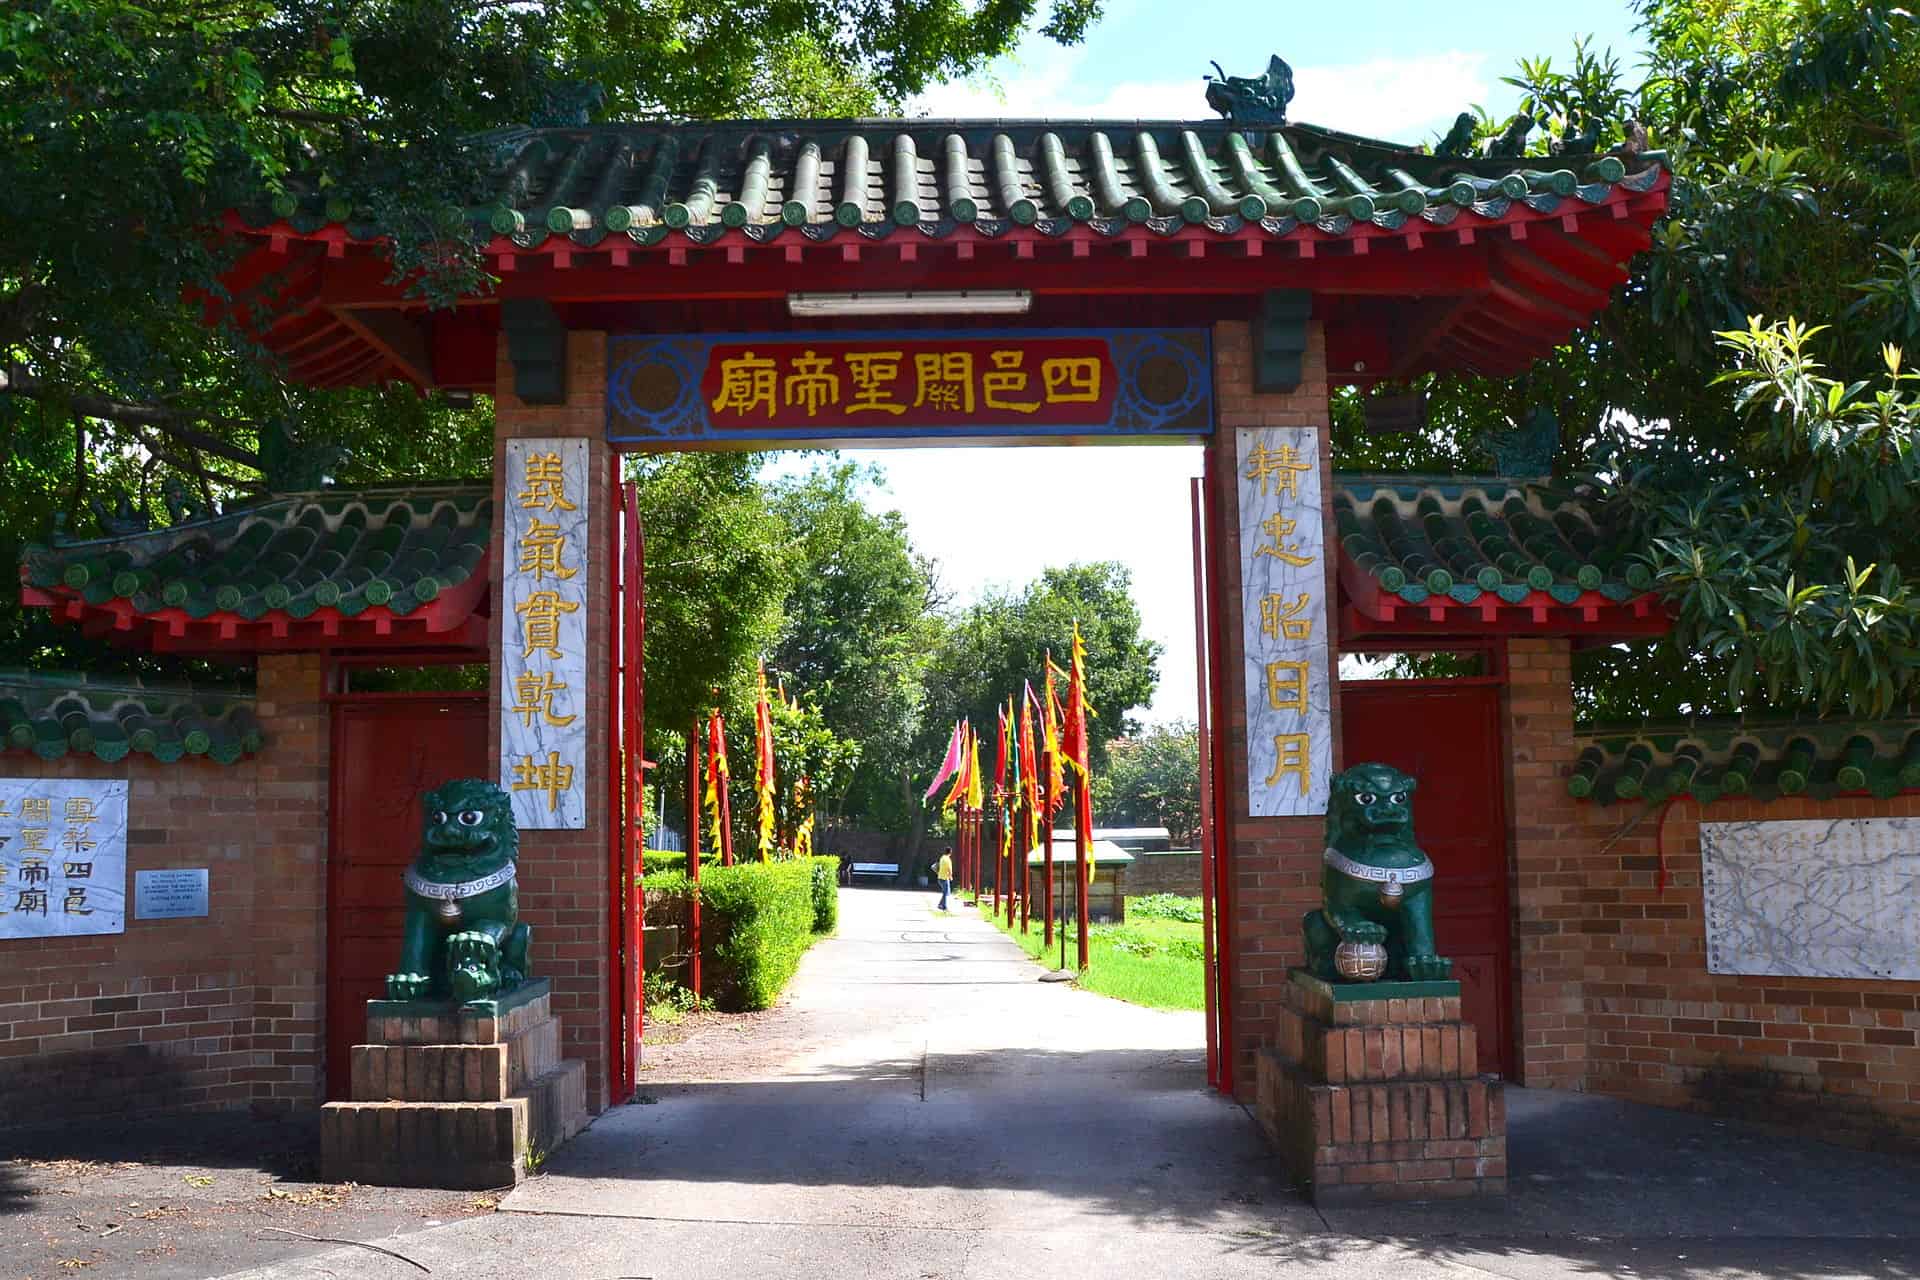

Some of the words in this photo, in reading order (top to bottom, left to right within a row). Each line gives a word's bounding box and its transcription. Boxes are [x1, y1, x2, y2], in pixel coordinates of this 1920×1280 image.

[511, 452, 579, 813] 義氣貫乾坤
[1246, 441, 1316, 798] 精忠昭日月
